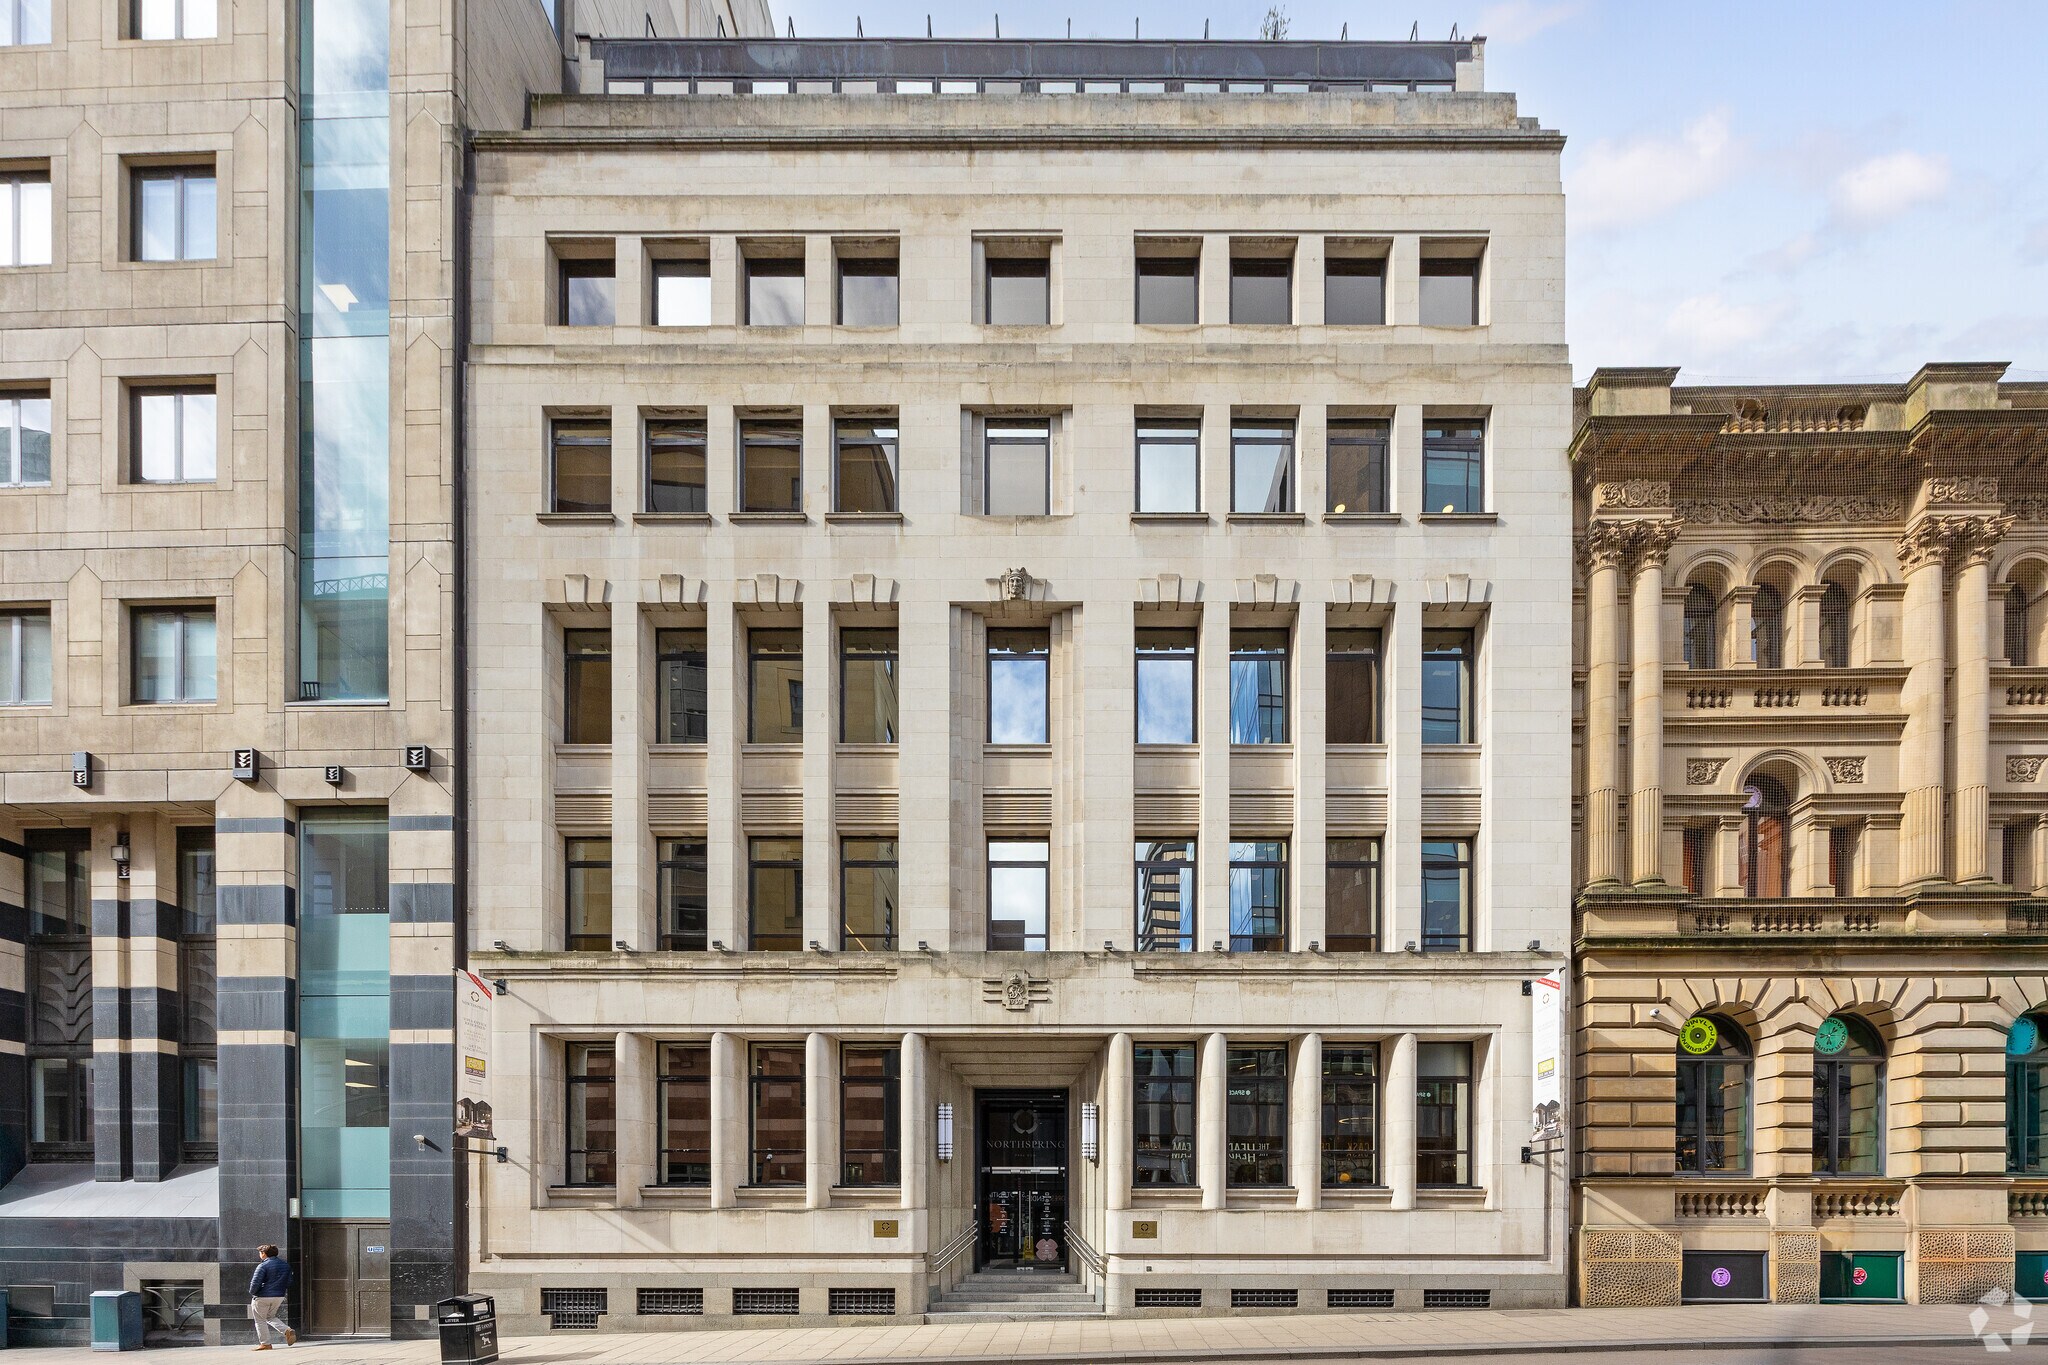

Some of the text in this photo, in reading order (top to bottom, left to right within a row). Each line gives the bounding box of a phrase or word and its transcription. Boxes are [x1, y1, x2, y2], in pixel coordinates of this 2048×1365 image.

[1685, 1018, 1708, 1028] VINYL
[1707, 1025, 1715, 1037] DJ
[986, 1140, 1065, 1149] NORTHSPRING
